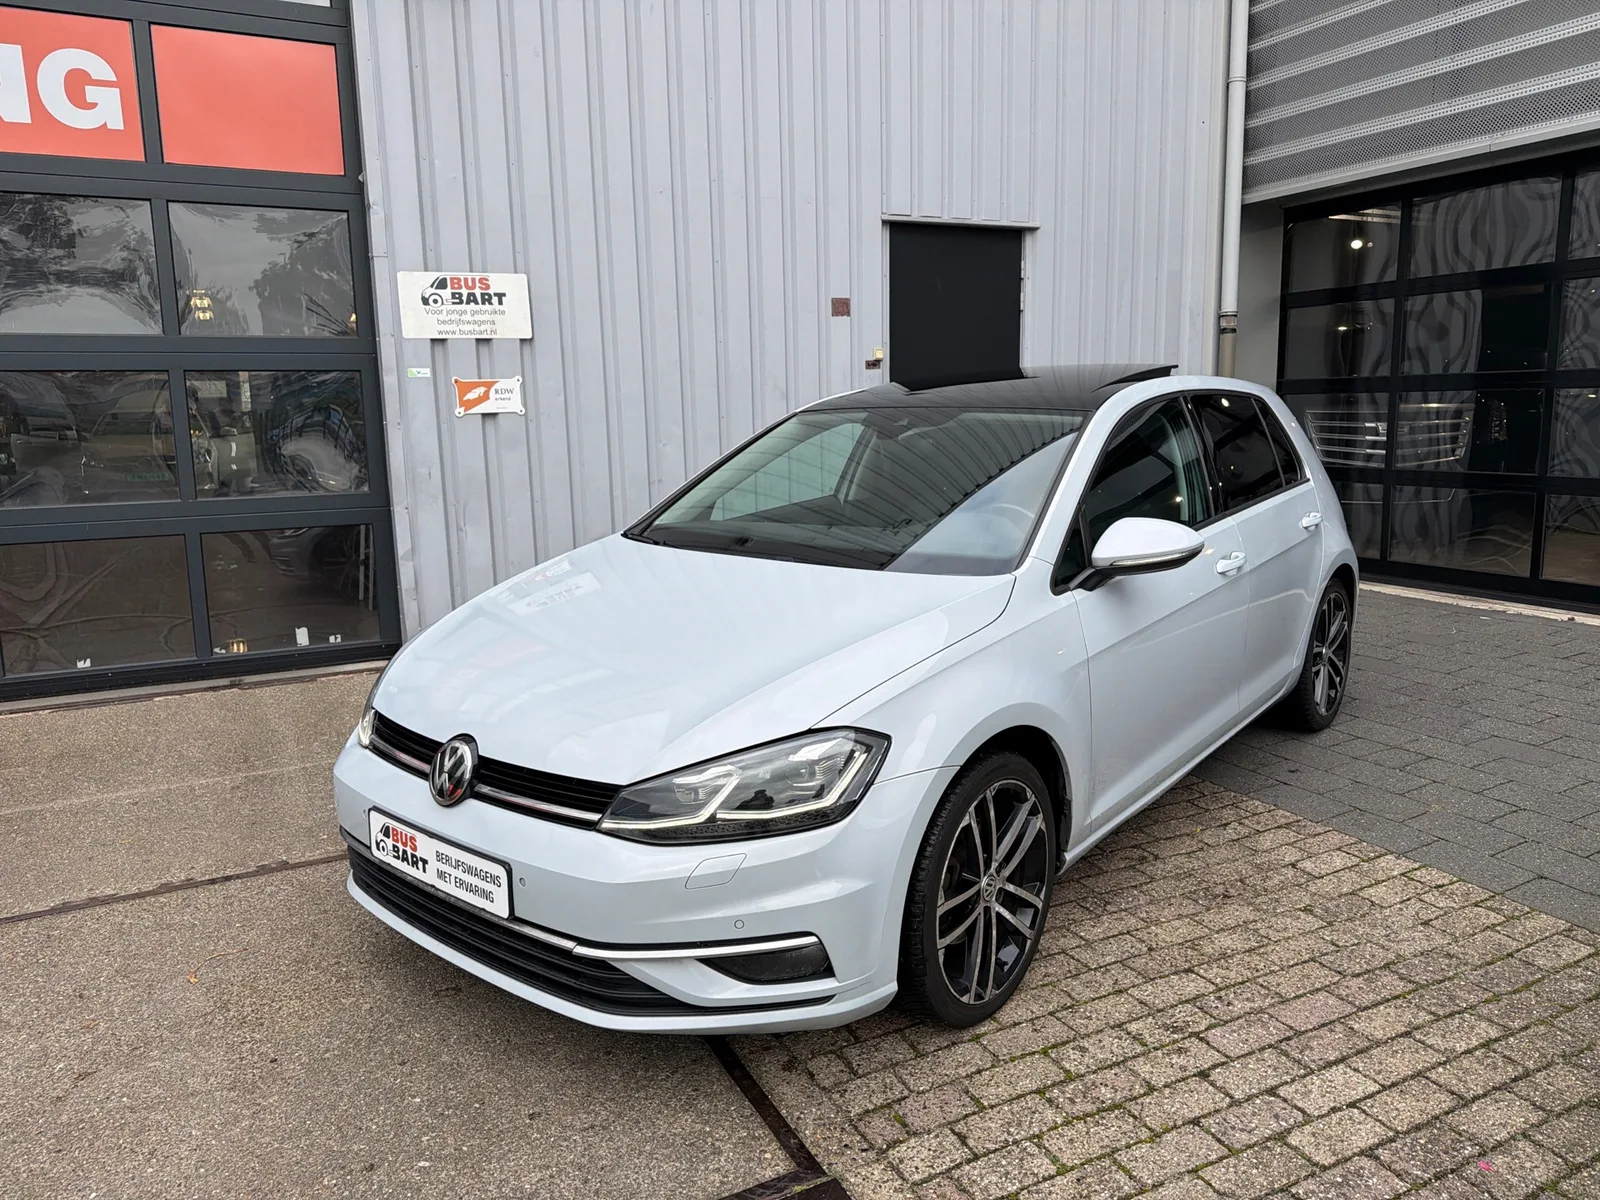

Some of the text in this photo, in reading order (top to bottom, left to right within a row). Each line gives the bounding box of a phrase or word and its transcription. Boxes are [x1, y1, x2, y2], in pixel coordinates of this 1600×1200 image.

[449, 276, 491, 291] BUS
[451, 292, 507, 306] BART
[424, 307, 506, 317] Voor jonge gebruikte
[437, 318, 496, 328] bedrijfswagens
[437, 328, 498, 336] www.busbart.nl
[391, 826, 418, 852] BUS
[391, 844, 428, 874] BART
[435, 850, 502, 888] BERIJFSWAGENS
[436, 868, 495, 903] MET ERVARING
